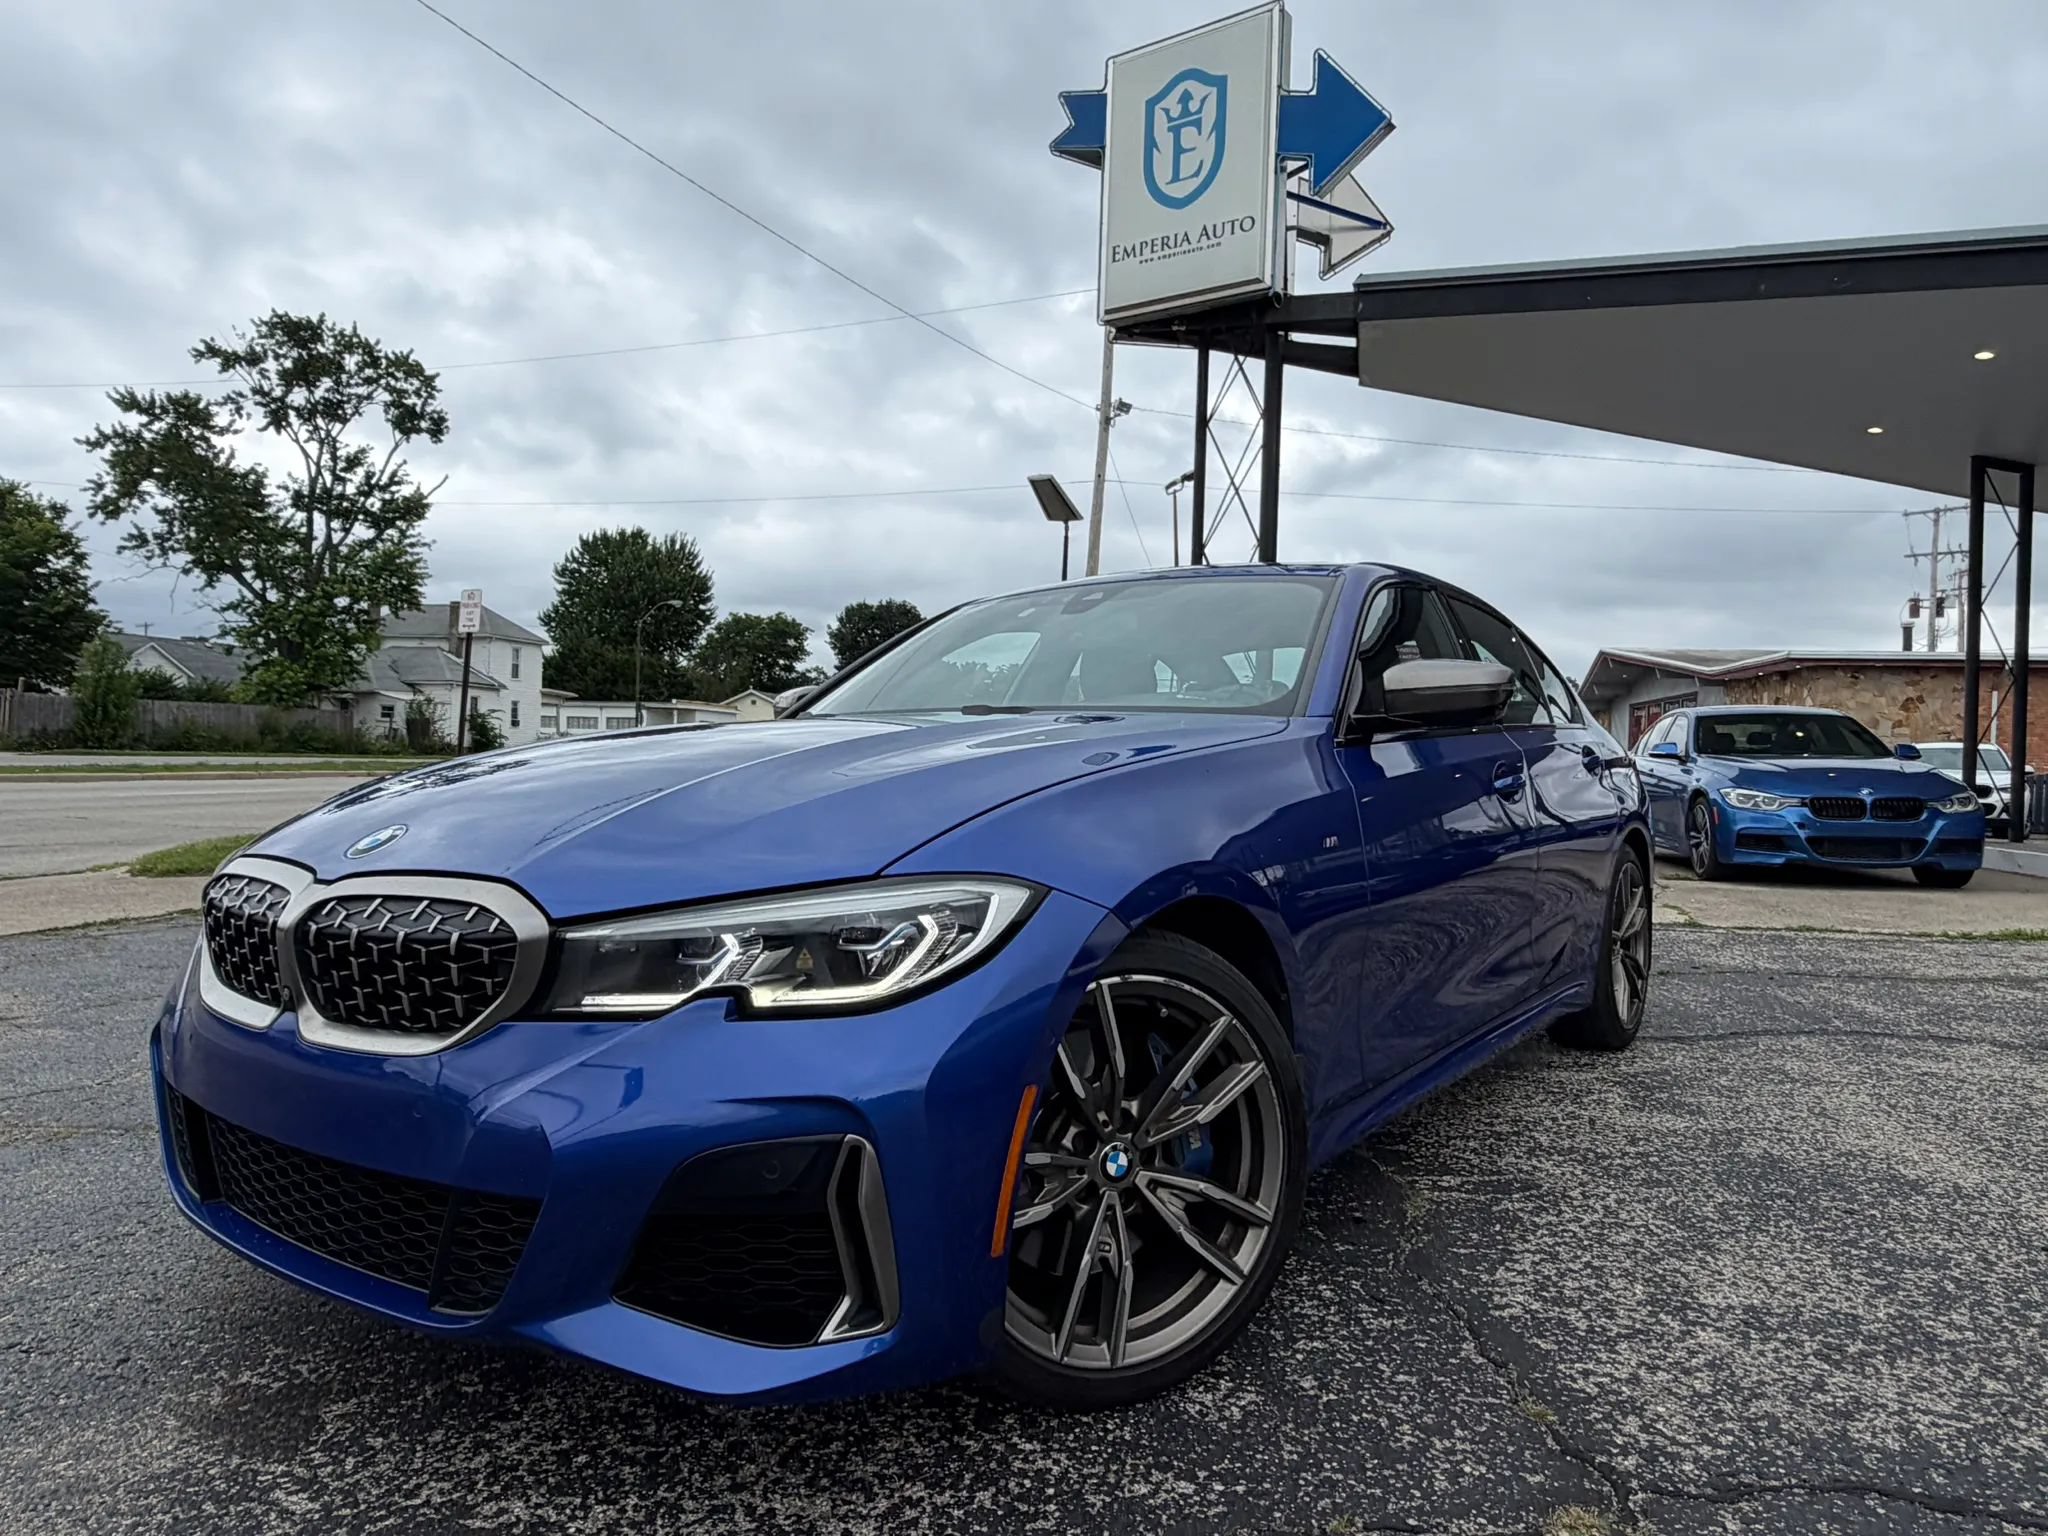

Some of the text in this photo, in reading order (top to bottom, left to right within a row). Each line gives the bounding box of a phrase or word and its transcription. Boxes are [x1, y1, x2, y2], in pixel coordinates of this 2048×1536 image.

[1165, 117, 1204, 186] E
[1111, 215, 1256, 264] EMPERIA AUTO
